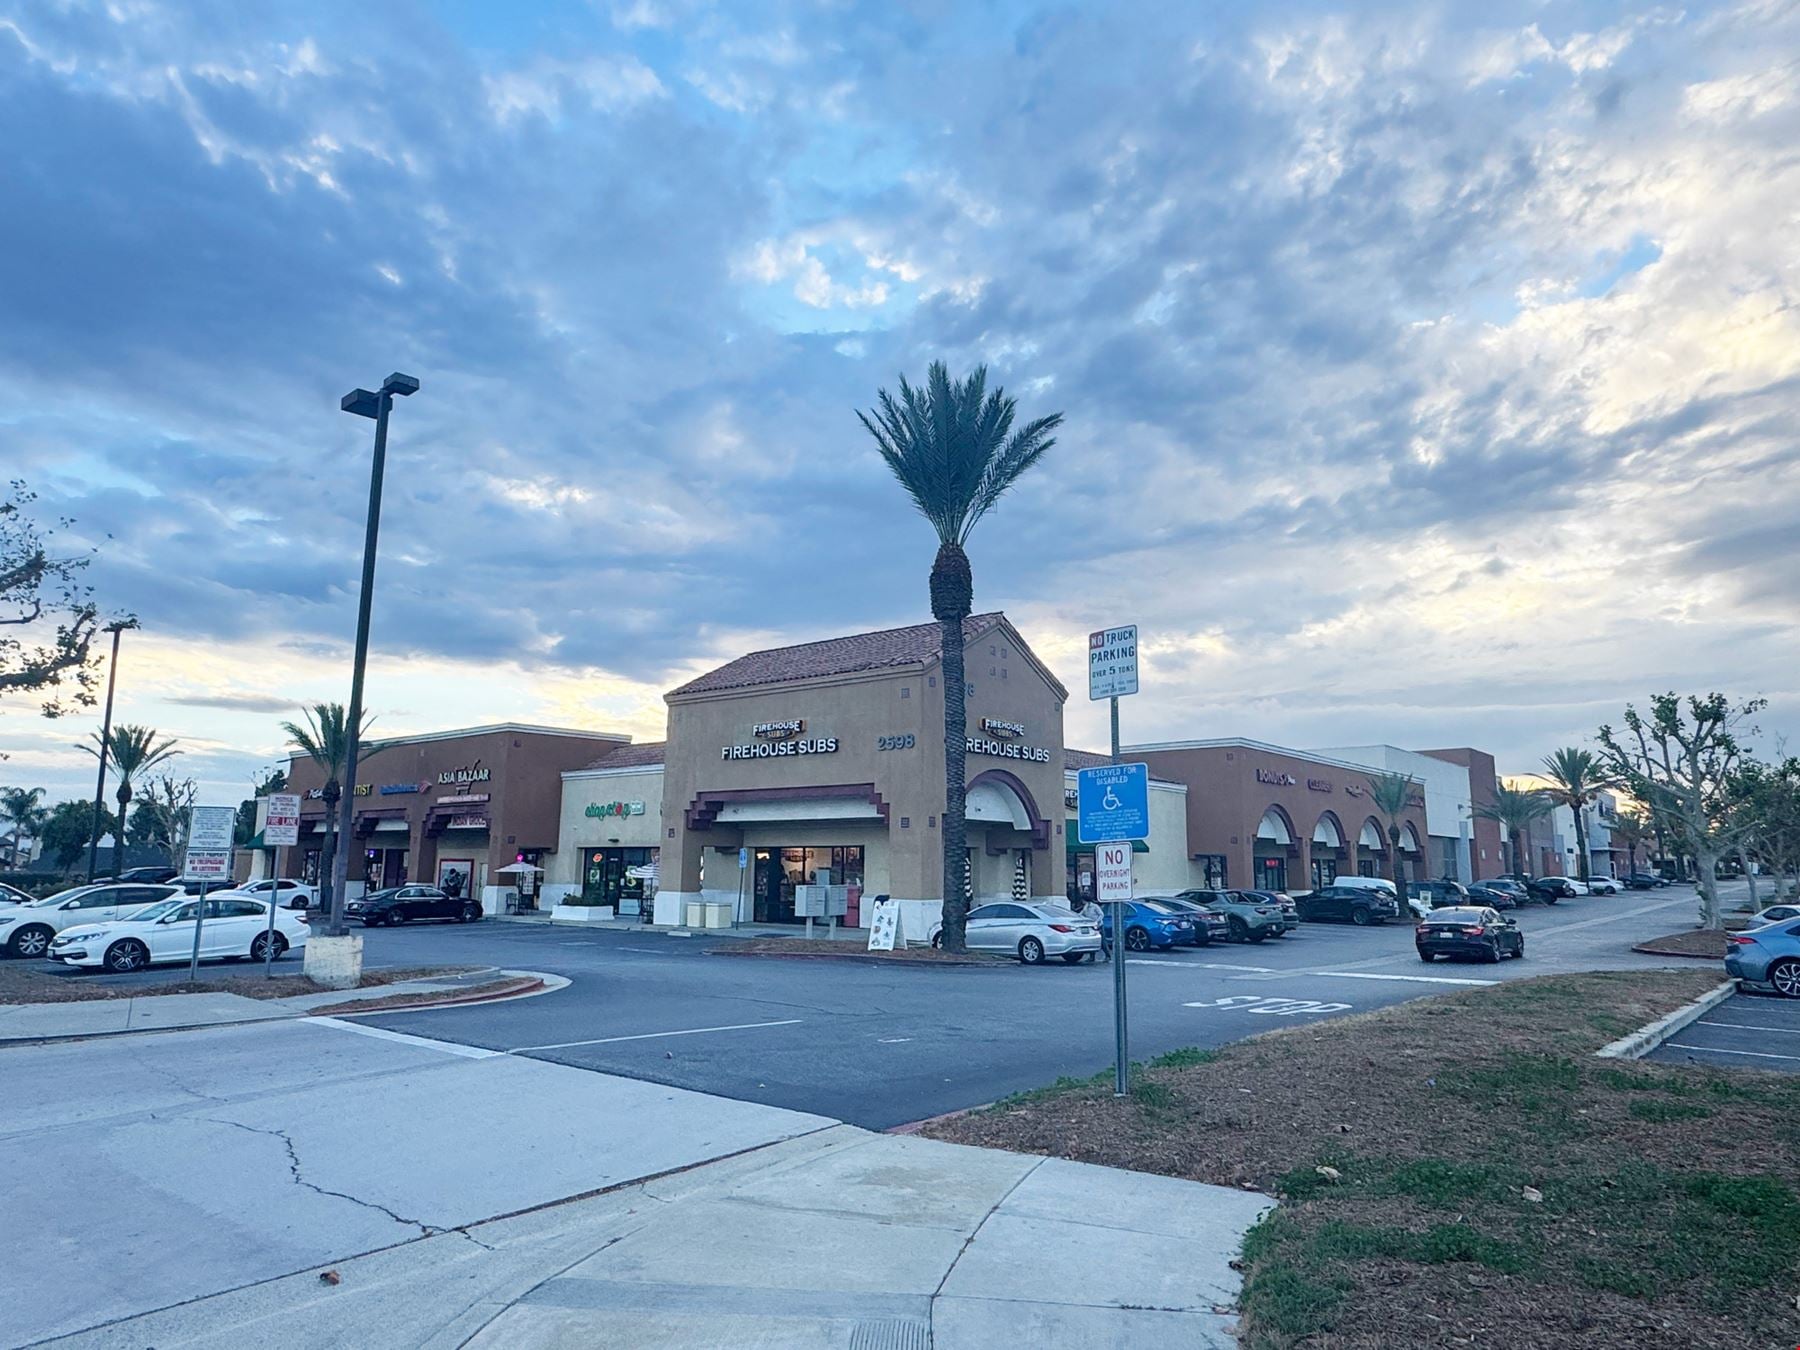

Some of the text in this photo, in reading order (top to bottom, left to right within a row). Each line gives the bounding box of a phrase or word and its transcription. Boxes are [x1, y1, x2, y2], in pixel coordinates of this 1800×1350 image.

[1091, 630, 1134, 647] NO TRUCK
[1091, 646, 1135, 664] PARKING
[1092, 665, 1134, 679] OVER 5 TONS
[752, 720, 800, 736] FIREHOUSE
[984, 719, 1025, 736] FIREHOUSE
[721, 738, 837, 760] FIREHOUSE SUBS
[877, 734, 916, 751] 2598
[966, 738, 1050, 762] REHOUSE SUBS
[437, 769, 489, 784] ASIA BAZAAR
[1087, 766, 1137, 778] RESERVED FOR
[1096, 775, 1129, 786] DISABLED
[1105, 850, 1123, 865] NO
[1100, 869, 1130, 878] OVERNIGHT
[1102, 882, 1129, 890] PARKING
[1181, 995, 1353, 1016] STOP
